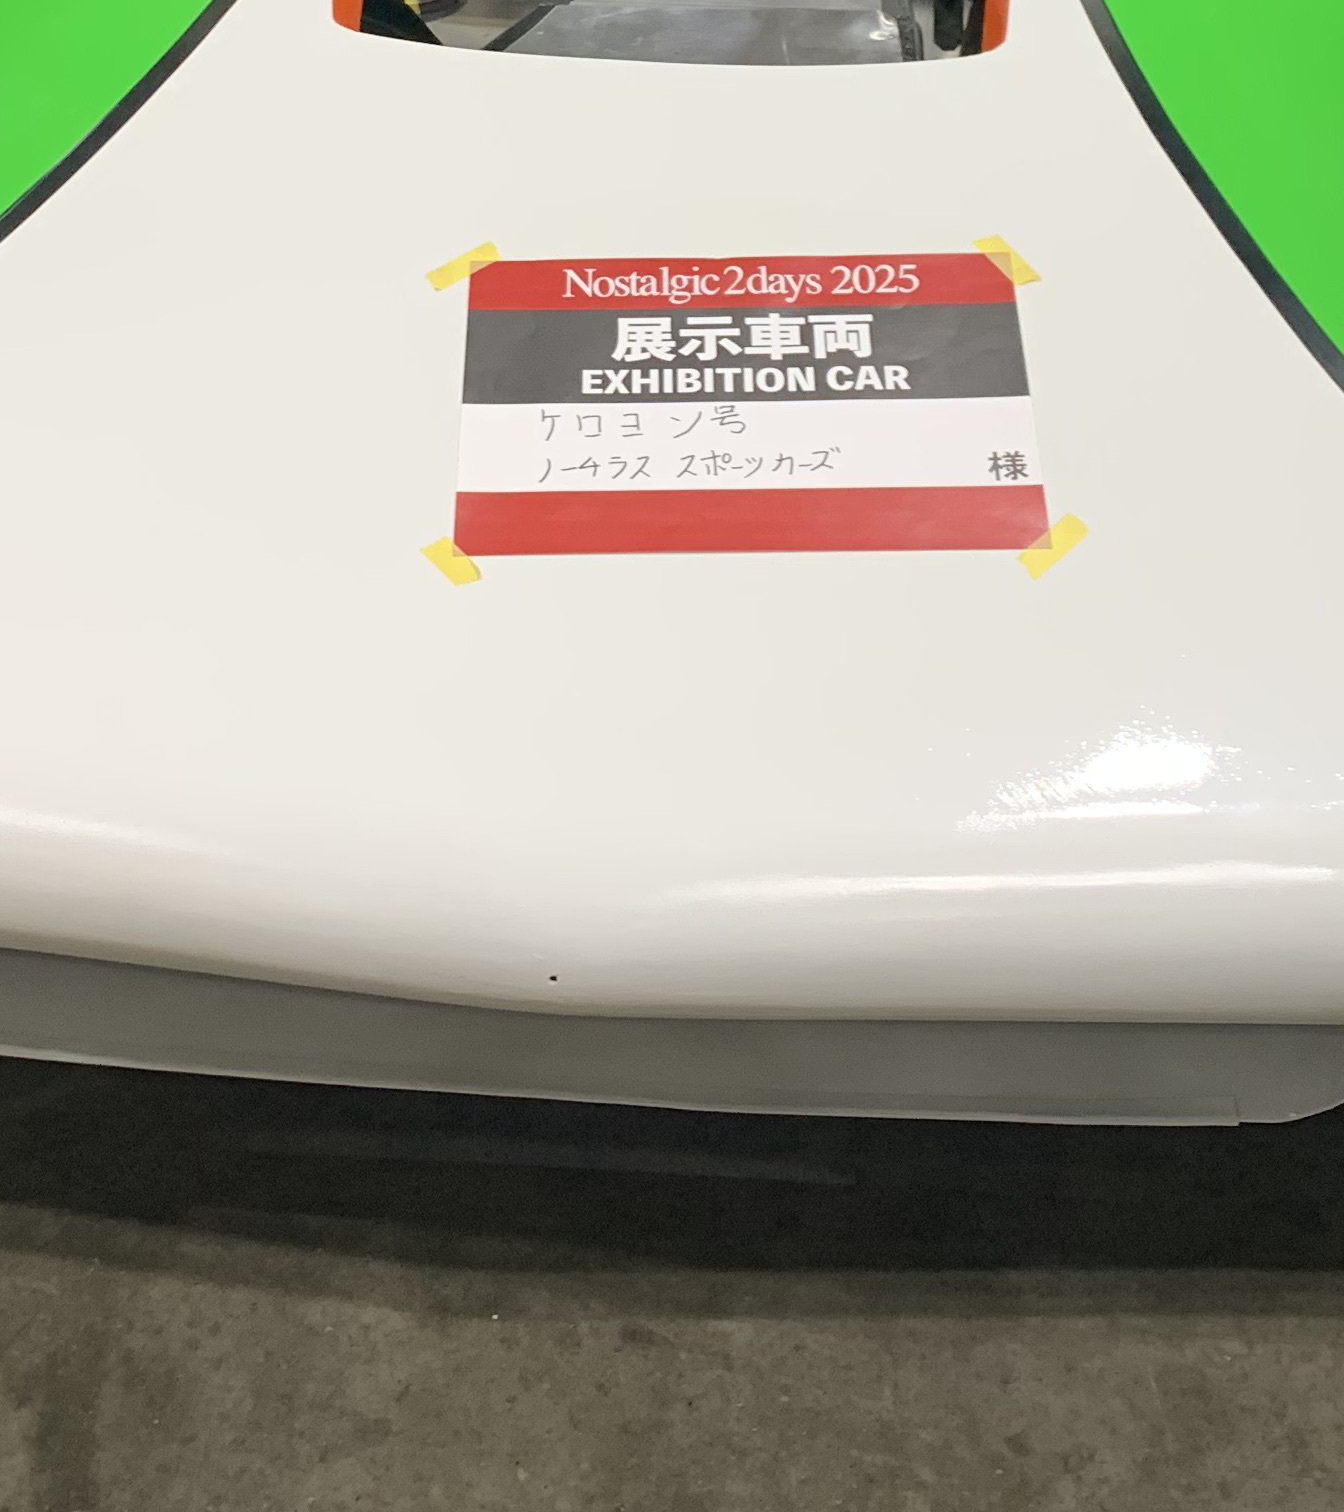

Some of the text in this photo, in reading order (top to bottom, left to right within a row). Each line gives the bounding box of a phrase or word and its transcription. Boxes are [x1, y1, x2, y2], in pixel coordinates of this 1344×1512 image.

[561, 264, 920, 304] Nostalgic 2days 2025
[611, 313, 874, 363] 展示車両
[581, 365, 912, 395] EXHIBITION CAR
[540, 405, 746, 442] ケロヨン号
[987, 450, 1030, 481] 様
